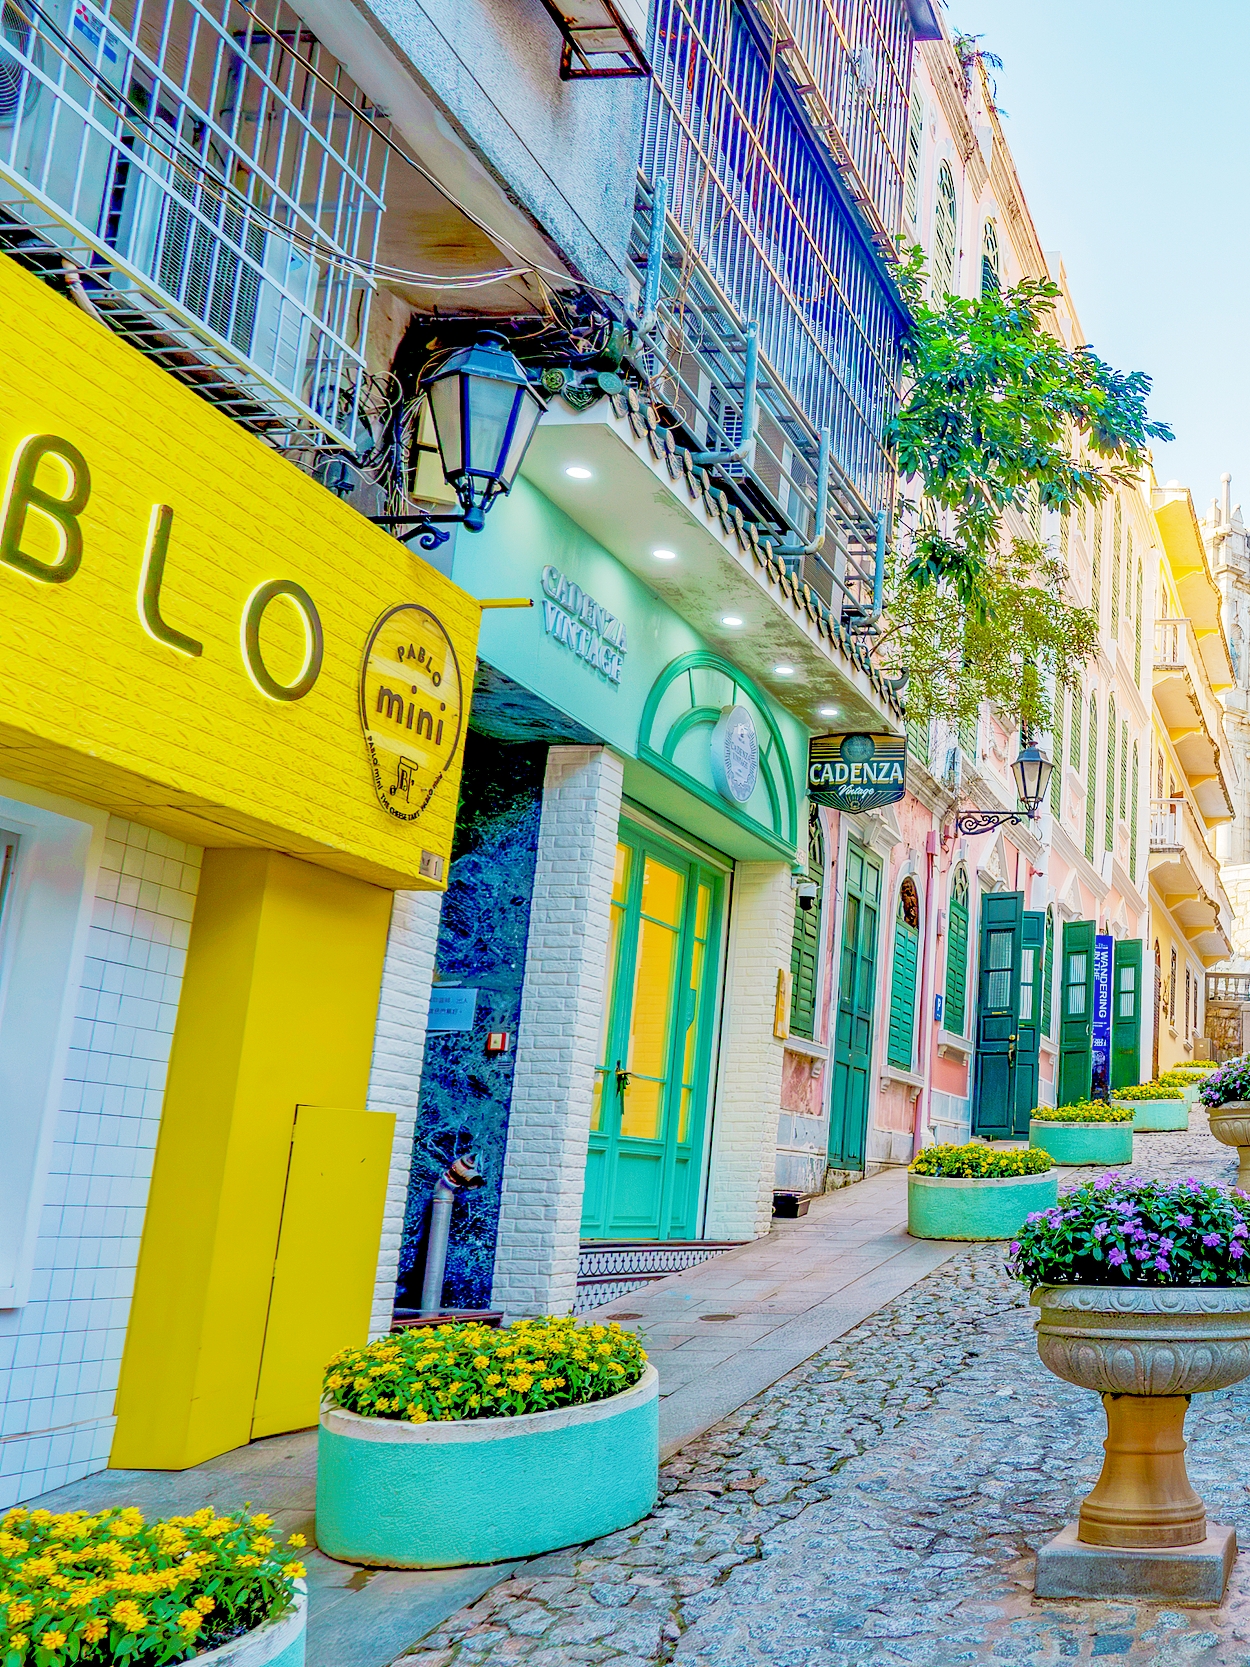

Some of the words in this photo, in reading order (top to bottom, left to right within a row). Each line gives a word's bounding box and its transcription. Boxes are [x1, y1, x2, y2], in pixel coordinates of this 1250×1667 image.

[541, 564, 628, 654] CADENZA
[541, 597, 625, 685] VINTAGE
[397, 643, 441, 687] PABLO
[376, 685, 446, 746] mini
[367, 735, 378, 766] PABLO
[374, 768, 384, 790] mini
[380, 793, 390, 809] THE
[809, 762, 904, 784] CADENZA
[838, 784, 875, 799] Vintage
[1098, 951, 1109, 1018] WANDERING
